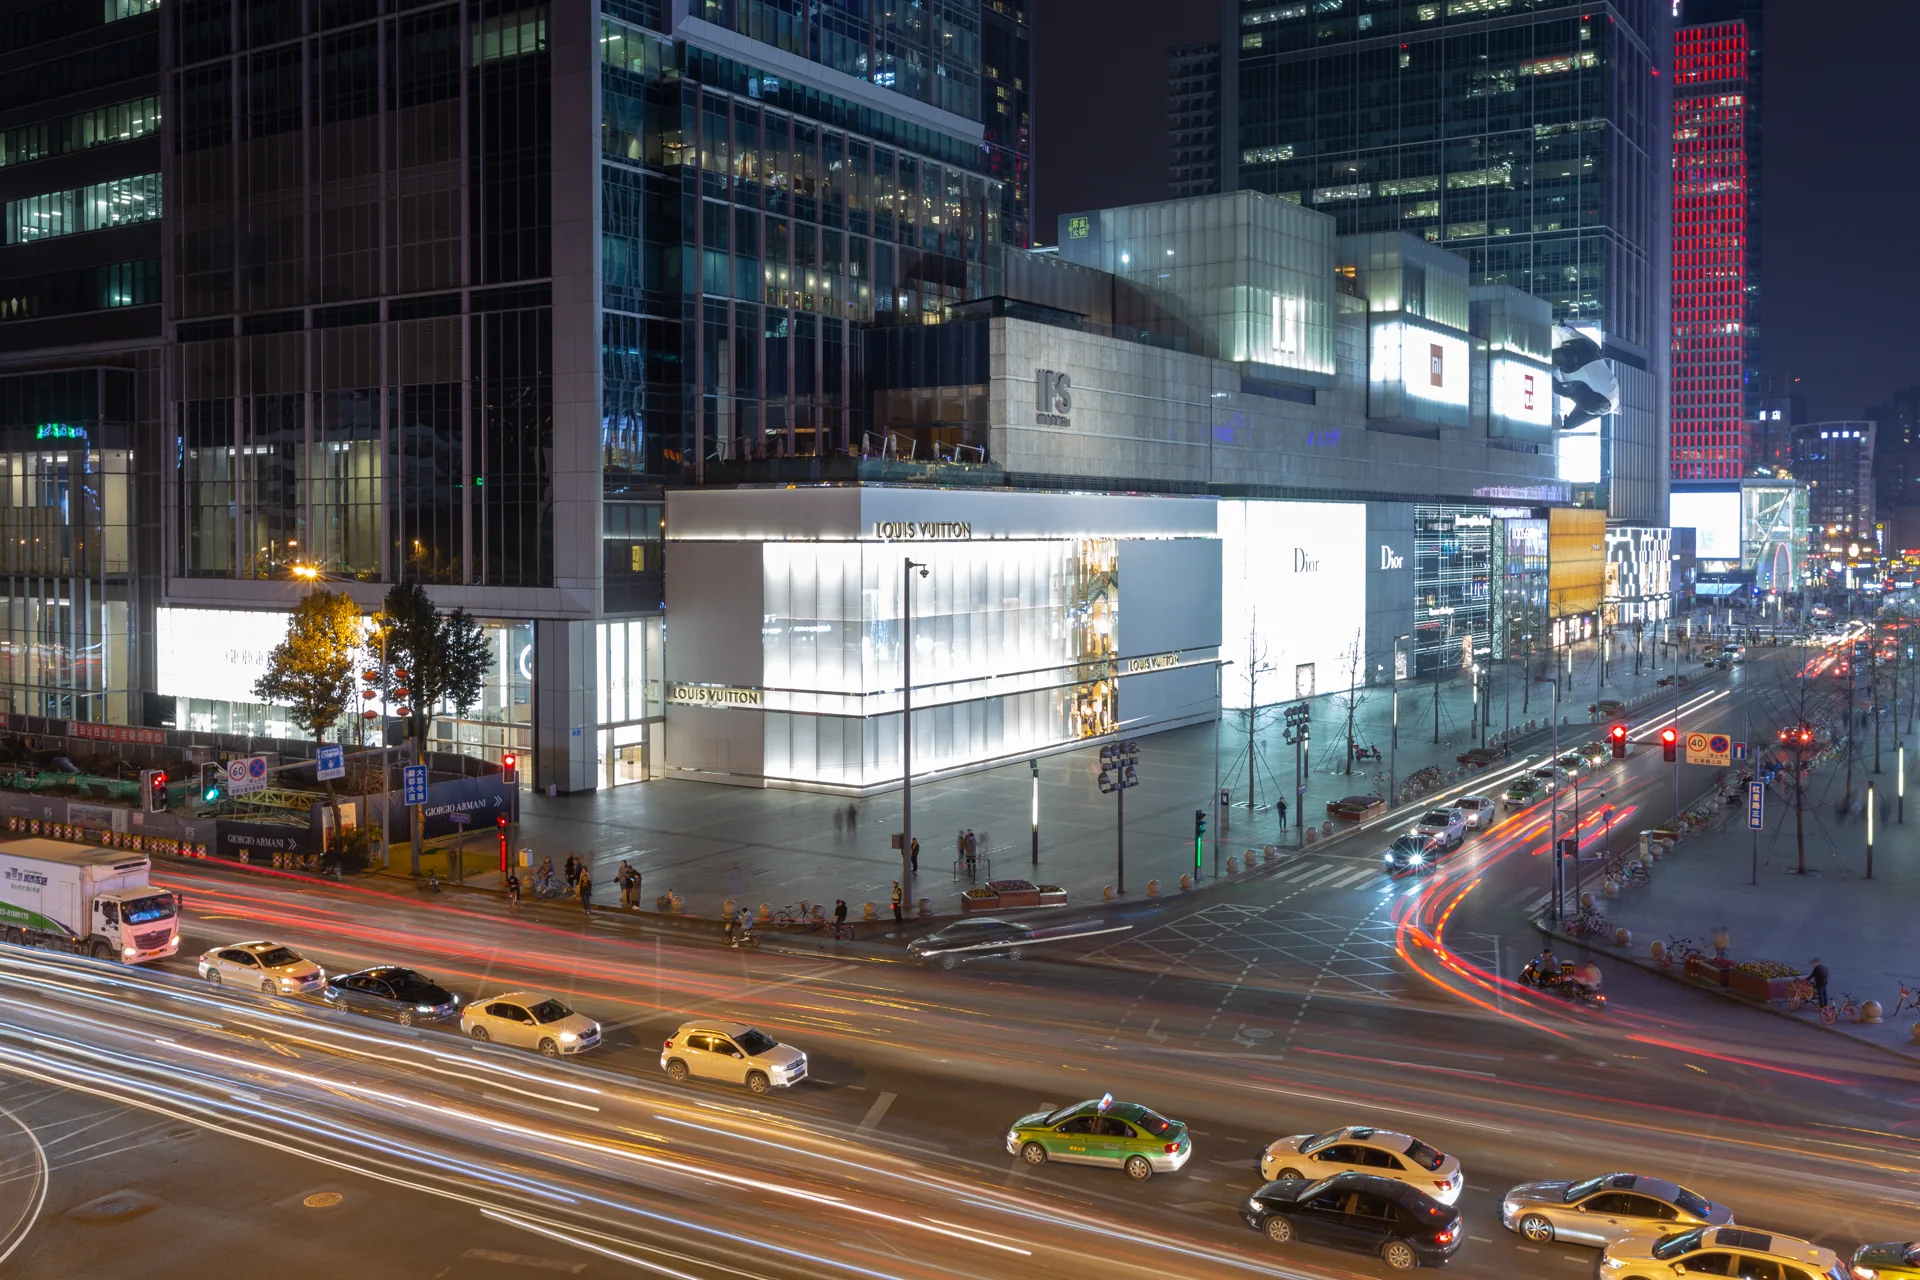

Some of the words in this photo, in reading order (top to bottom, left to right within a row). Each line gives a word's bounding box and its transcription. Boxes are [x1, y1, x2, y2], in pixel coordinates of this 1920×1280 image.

[1035, 368, 1071, 414] IFS
[874, 521, 914, 538] LOUIS
[917, 521, 971, 539] VUITTON
[1294, 547, 1320, 573] Dior
[1381, 545, 1403, 570] Dior
[1128, 658, 1150, 672] LOUIS
[1151, 654, 1179, 668] VUITTON
[673, 687, 706, 700] LOUIS
[708, 690, 757, 704] VUITTON
[1691, 739, 1703, 747] 40
[232, 766, 244, 776] 60
[416, 768, 425, 800] 大慈寺路
[43, 806, 52, 817] IFS
[425, 804, 455, 817] GIORGIO
[456, 799, 486, 811] ARMANI
[1751, 785, 1761, 826] 红星路三段
[186, 826, 195, 837] IFS
[227, 834, 255, 845] GIORGIO
[256, 837, 284, 848] ARMANI
